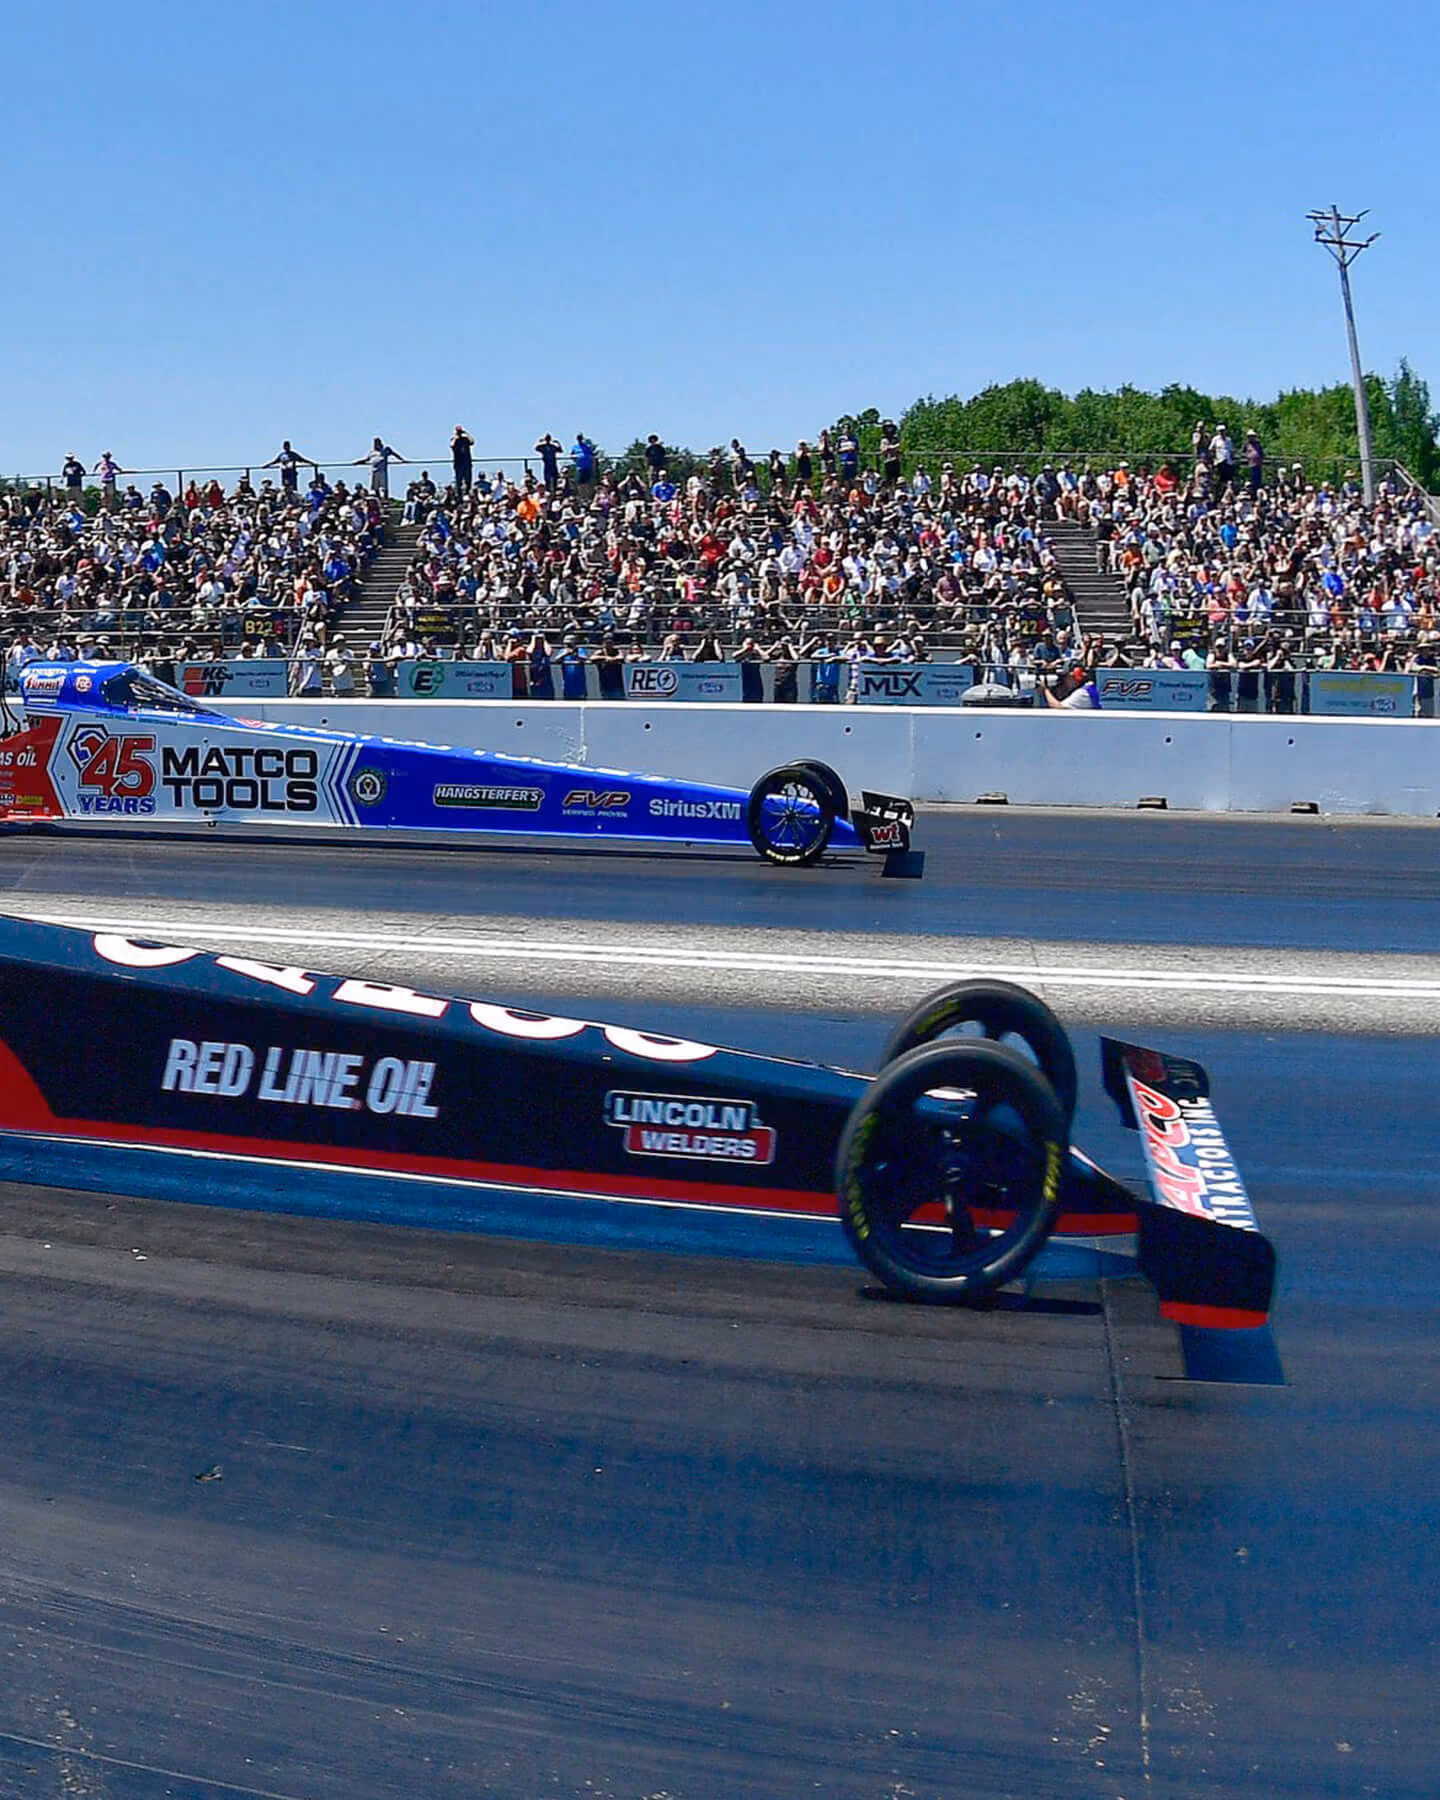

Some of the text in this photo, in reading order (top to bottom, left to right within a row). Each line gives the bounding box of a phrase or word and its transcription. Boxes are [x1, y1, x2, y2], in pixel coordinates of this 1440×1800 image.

[1101, 679, 1154, 696] FVP
[16, 752, 38, 767] OIL
[79, 734, 157, 797] 45
[162, 747, 319, 778] MATCO
[79, 795, 156, 815] YEARS
[162, 777, 319, 811] TOOLS
[436, 786, 539, 802] HANGSTERFER'S
[562, 790, 631, 808] FVP
[649, 799, 742, 820] SiriusXM
[161, 1038, 440, 1118] RED LINE OIL
[613, 1098, 748, 1131] LINCOLN
[640, 1130, 757, 1158] WELDERS
